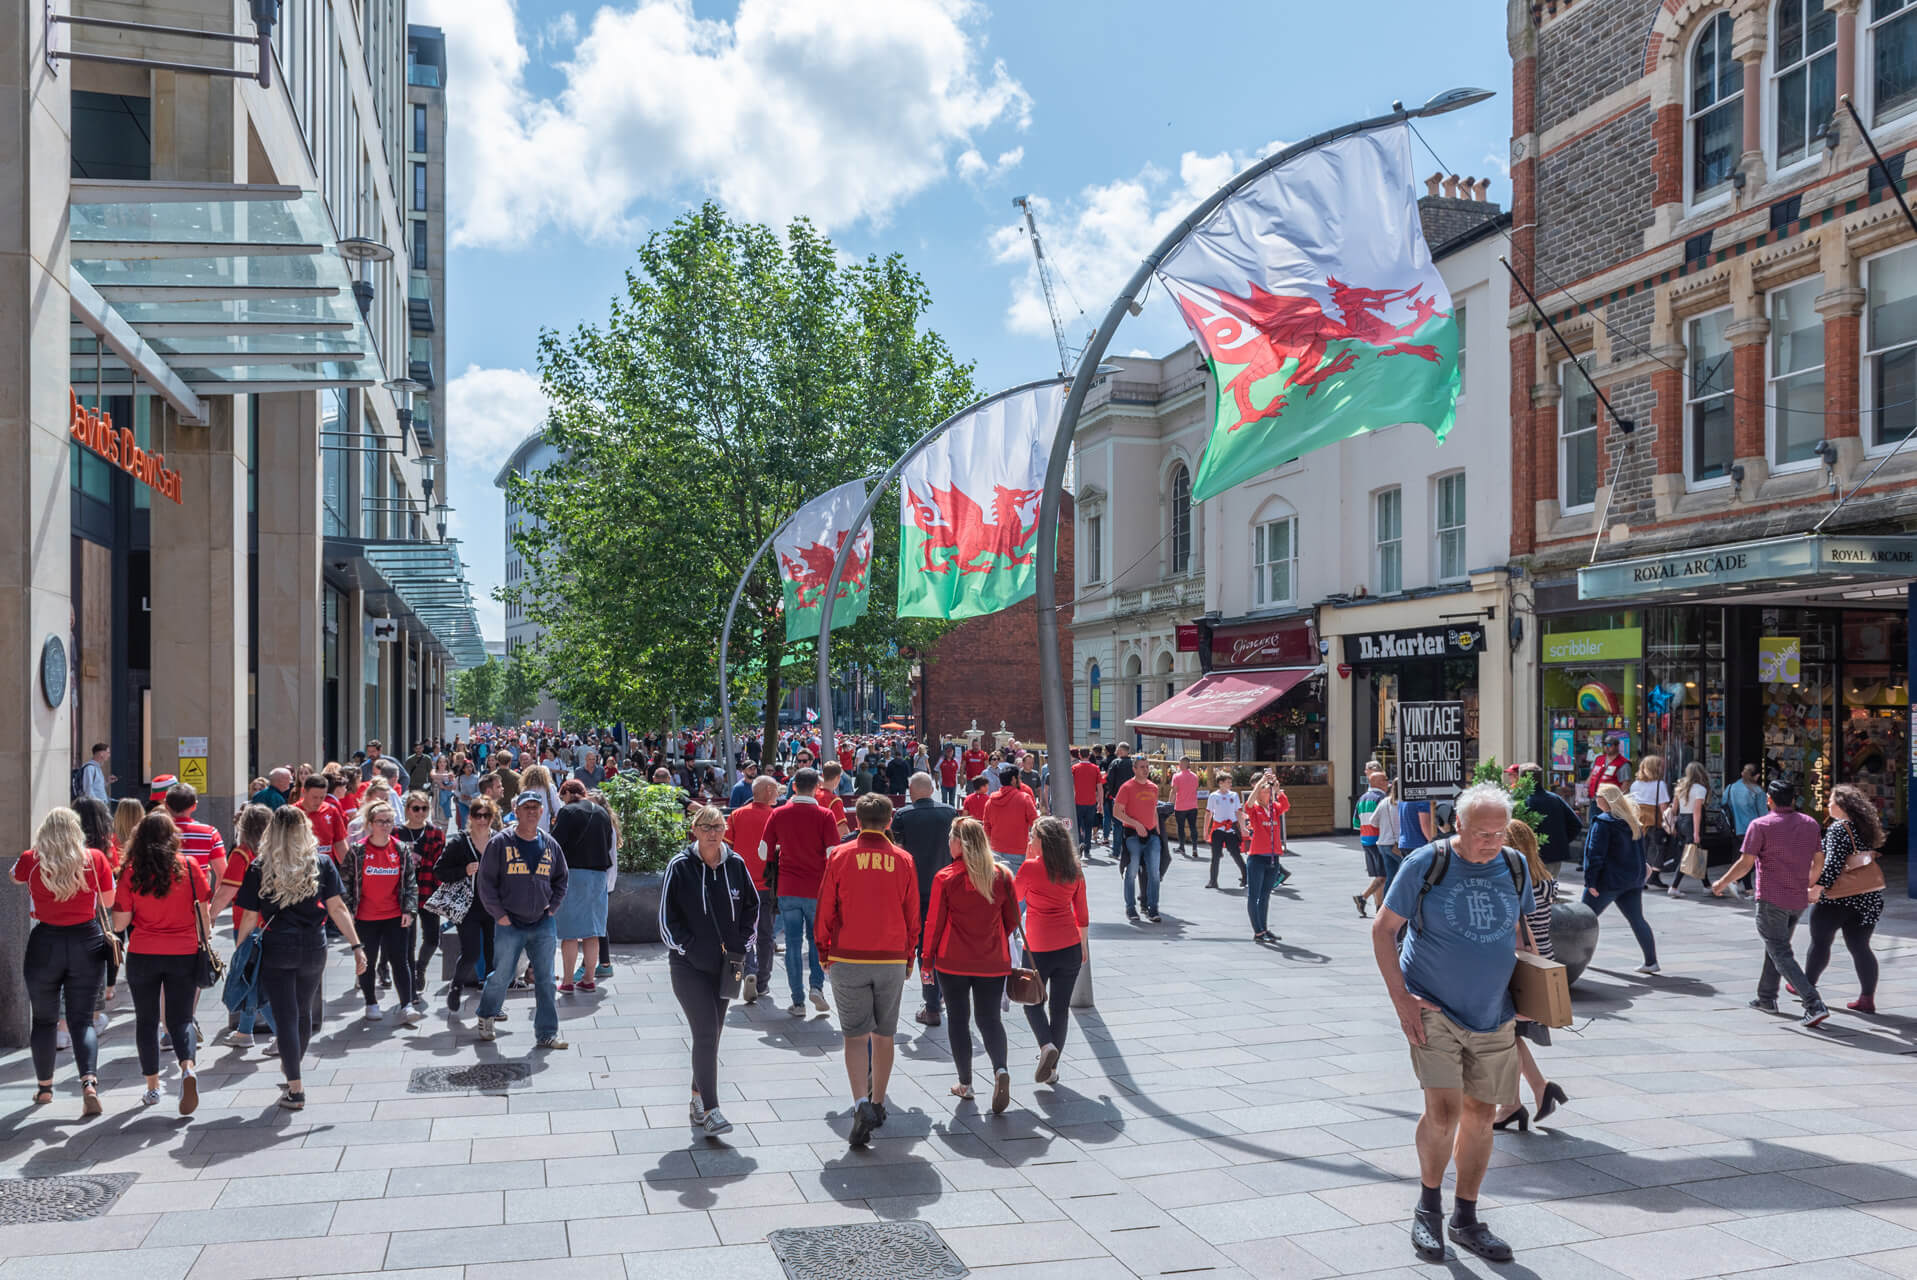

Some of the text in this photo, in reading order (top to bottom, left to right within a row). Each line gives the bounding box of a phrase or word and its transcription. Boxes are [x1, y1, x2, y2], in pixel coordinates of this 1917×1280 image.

[121, 427, 157, 488] Dewi
[155, 452, 183, 504] Sant
[1831, 549, 1914, 562] ROYAL ARCADE
[1634, 554, 1748, 582] ROYAL ARCADE
[1550, 638, 1604, 657] scribbler
[1402, 707, 1460, 736] VINTAGE
[1404, 741, 1460, 762] REWORKED
[1405, 761, 1460, 782] CLOTHING
[856, 853, 895, 872] WRU
[1463, 878, 1492, 889] LEWIS
